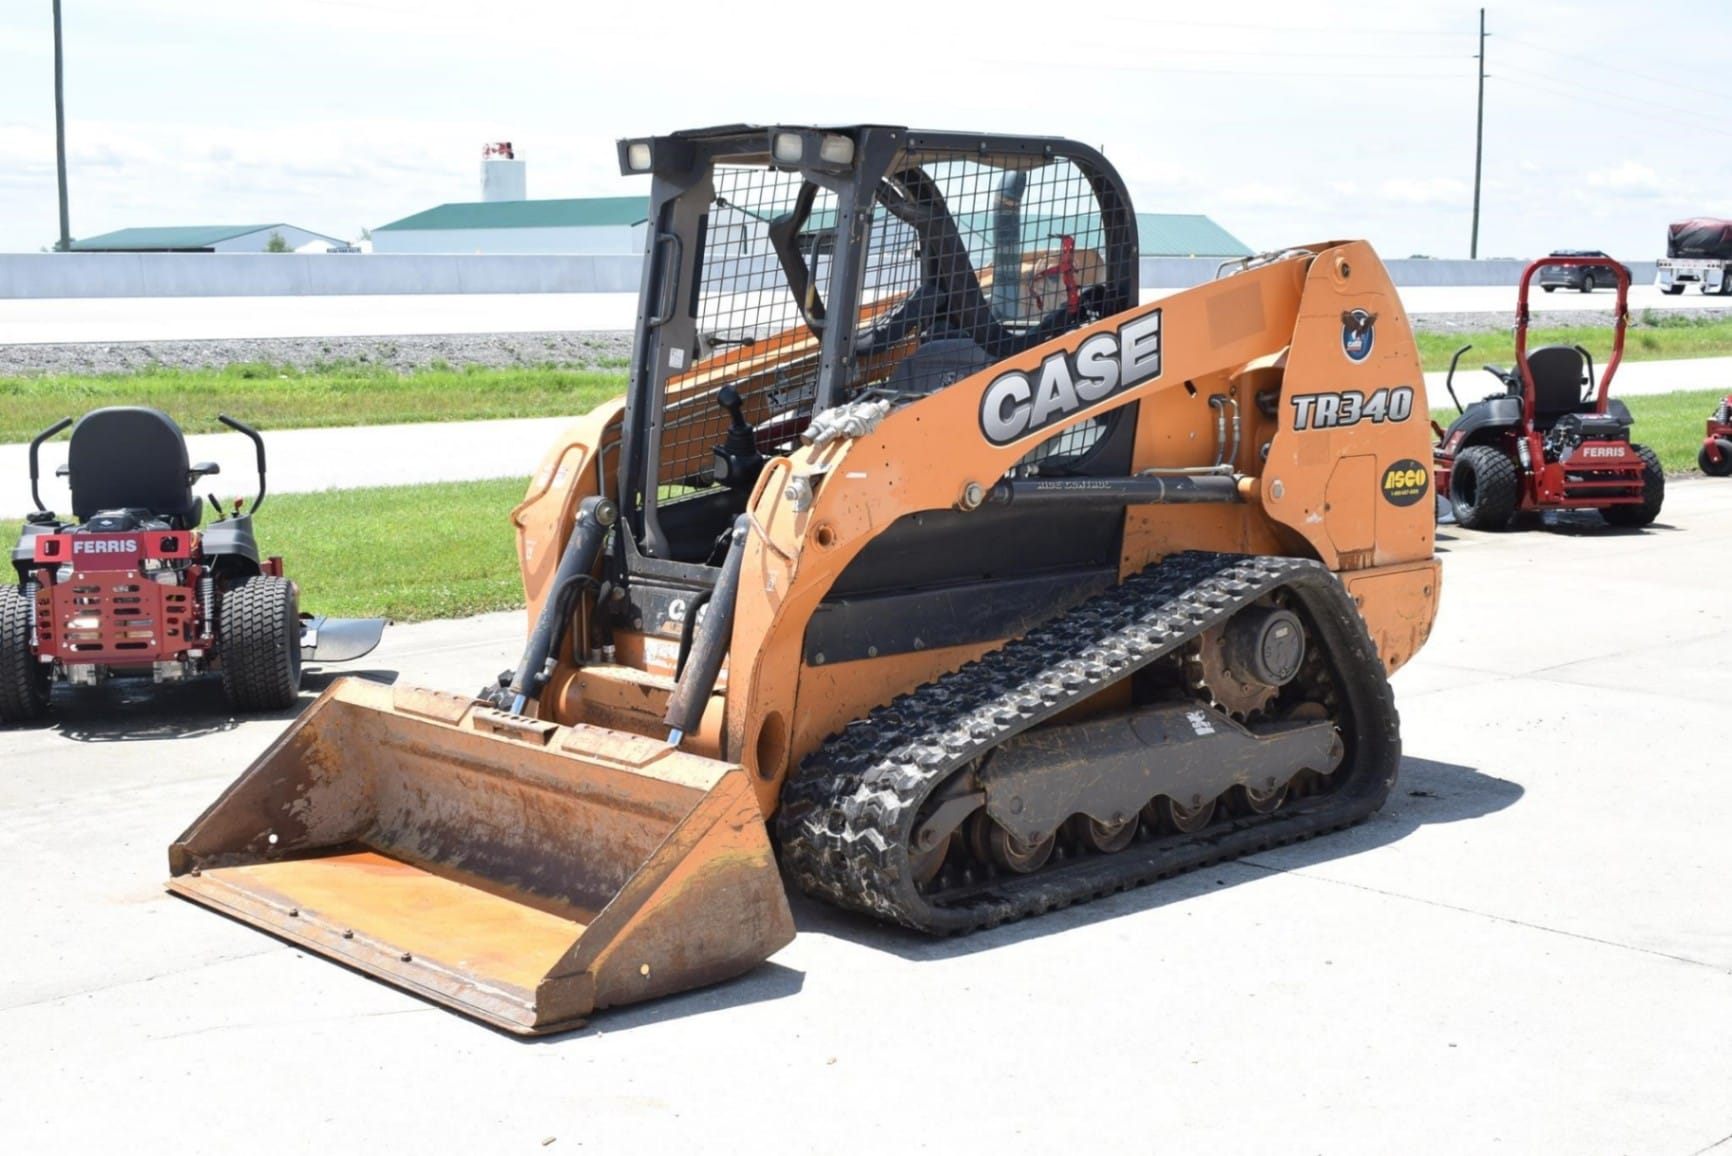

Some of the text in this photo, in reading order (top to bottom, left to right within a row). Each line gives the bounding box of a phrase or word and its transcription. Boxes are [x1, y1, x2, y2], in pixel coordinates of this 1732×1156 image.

[980, 308, 1161, 443] CASE
[1291, 387, 1414, 431] TR340
[1583, 447, 1625, 458] FERRIS
[73, 539, 137, 554] FERRIS
